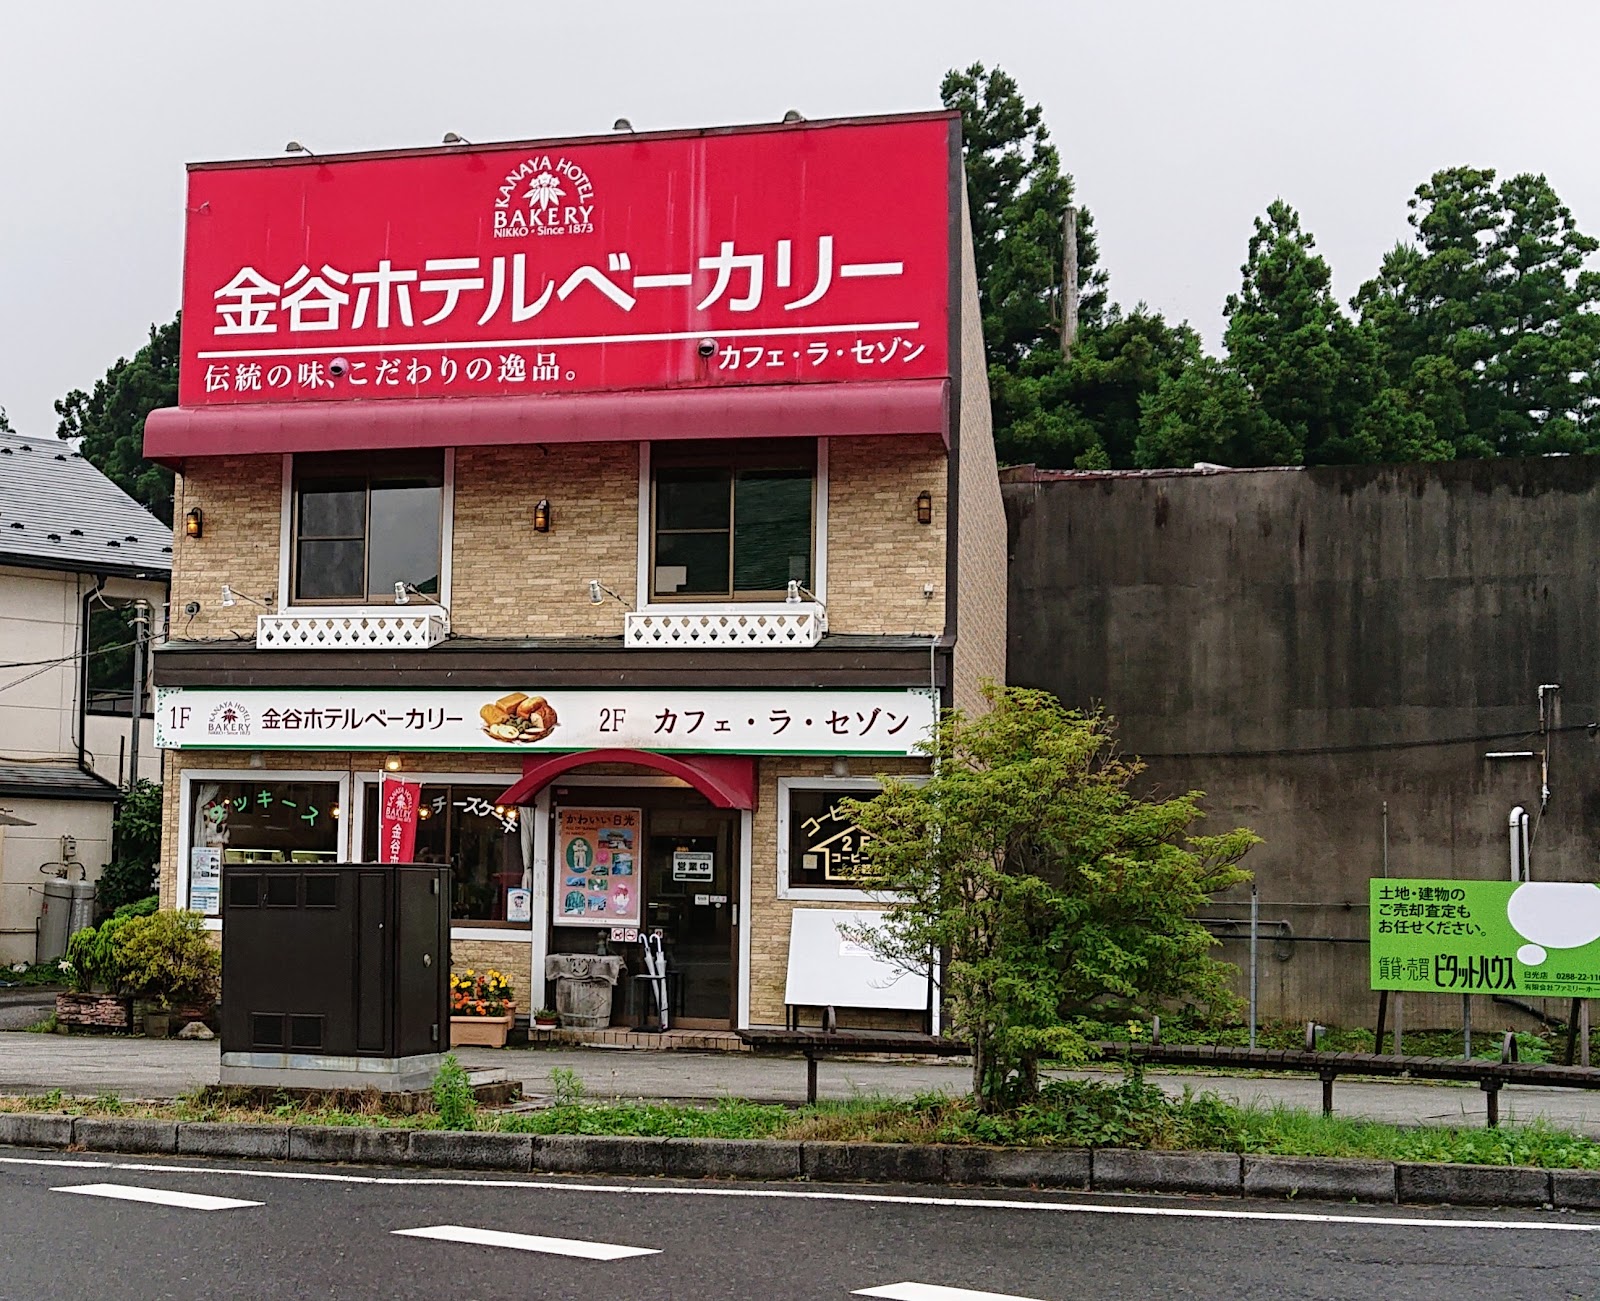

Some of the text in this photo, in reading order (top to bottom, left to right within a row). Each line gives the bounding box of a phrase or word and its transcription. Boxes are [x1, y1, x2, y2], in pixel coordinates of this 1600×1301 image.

[495, 155, 594, 208] KANAYA HOTEL
[494, 205, 594, 228] BAKERY
[493, 223, 594, 238] NIKKO Since 1873
[213, 235, 904, 337] 金谷ホテルベーカリー
[718, 336, 926, 370] カフェ・ラ・セゾン
[203, 352, 579, 394] 伝統の味、こだわりの逸品。
[170, 707, 191, 729] 1F
[208, 701, 251, 722] KANAYA HOTEL
[261, 707, 463, 730] 金谷ホテルベーカリー
[599, 707, 626, 732] 2F
[653, 707, 909, 737] カフェ・ラ・セゾン
[208, 723, 251, 732] BAKERY
[566, 814, 635, 826] かわいい日光
[1379, 886, 1466, 902] 土地・建物の
[1379, 903, 1471, 918] ご売却査定も
[1378, 921, 1487, 937] お任せください。
[1379, 953, 1517, 990] 賃貸・売買 ピタットハウス
[1524, 971, 1548, 980] 日光店
